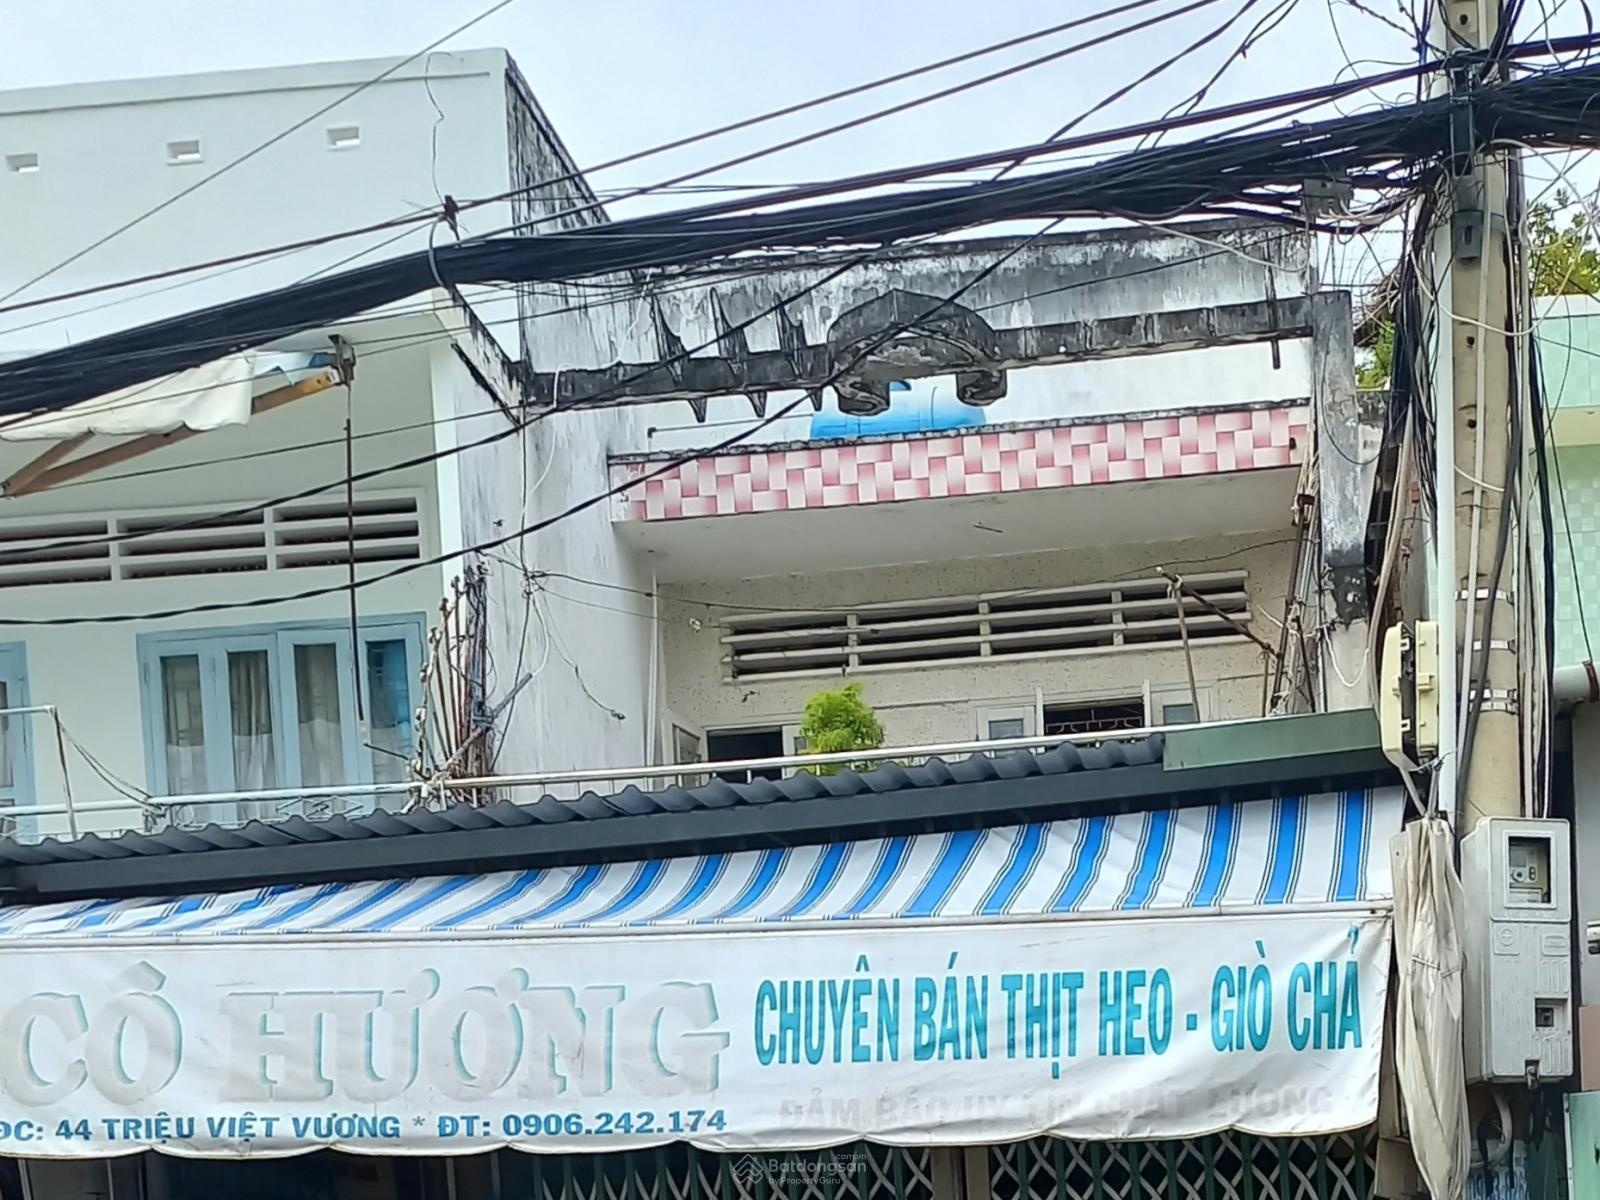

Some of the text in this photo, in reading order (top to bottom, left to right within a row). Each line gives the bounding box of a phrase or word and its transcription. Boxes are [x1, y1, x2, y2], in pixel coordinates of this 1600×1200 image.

[0, 958, 731, 1106] CÔ HƯƠNG
[754, 954, 900, 1066] CHUYÊN
[913, 951, 989, 1062] BÁN
[1001, 971, 1084, 1080] THỊT
[1098, 967, 1173, 1056] HEO
[1210, 939, 1273, 1053] GIÒ
[55, 1119, 92, 1141] 44
[102, 1113, 195, 1144] TRIỆU
[206, 1112, 280, 1142] VIỆT
[292, 1113, 401, 1139] VƯƠNG
[437, 1114, 490, 1137] ĐT:
[502, 1109, 727, 1137] 0906.242.174
